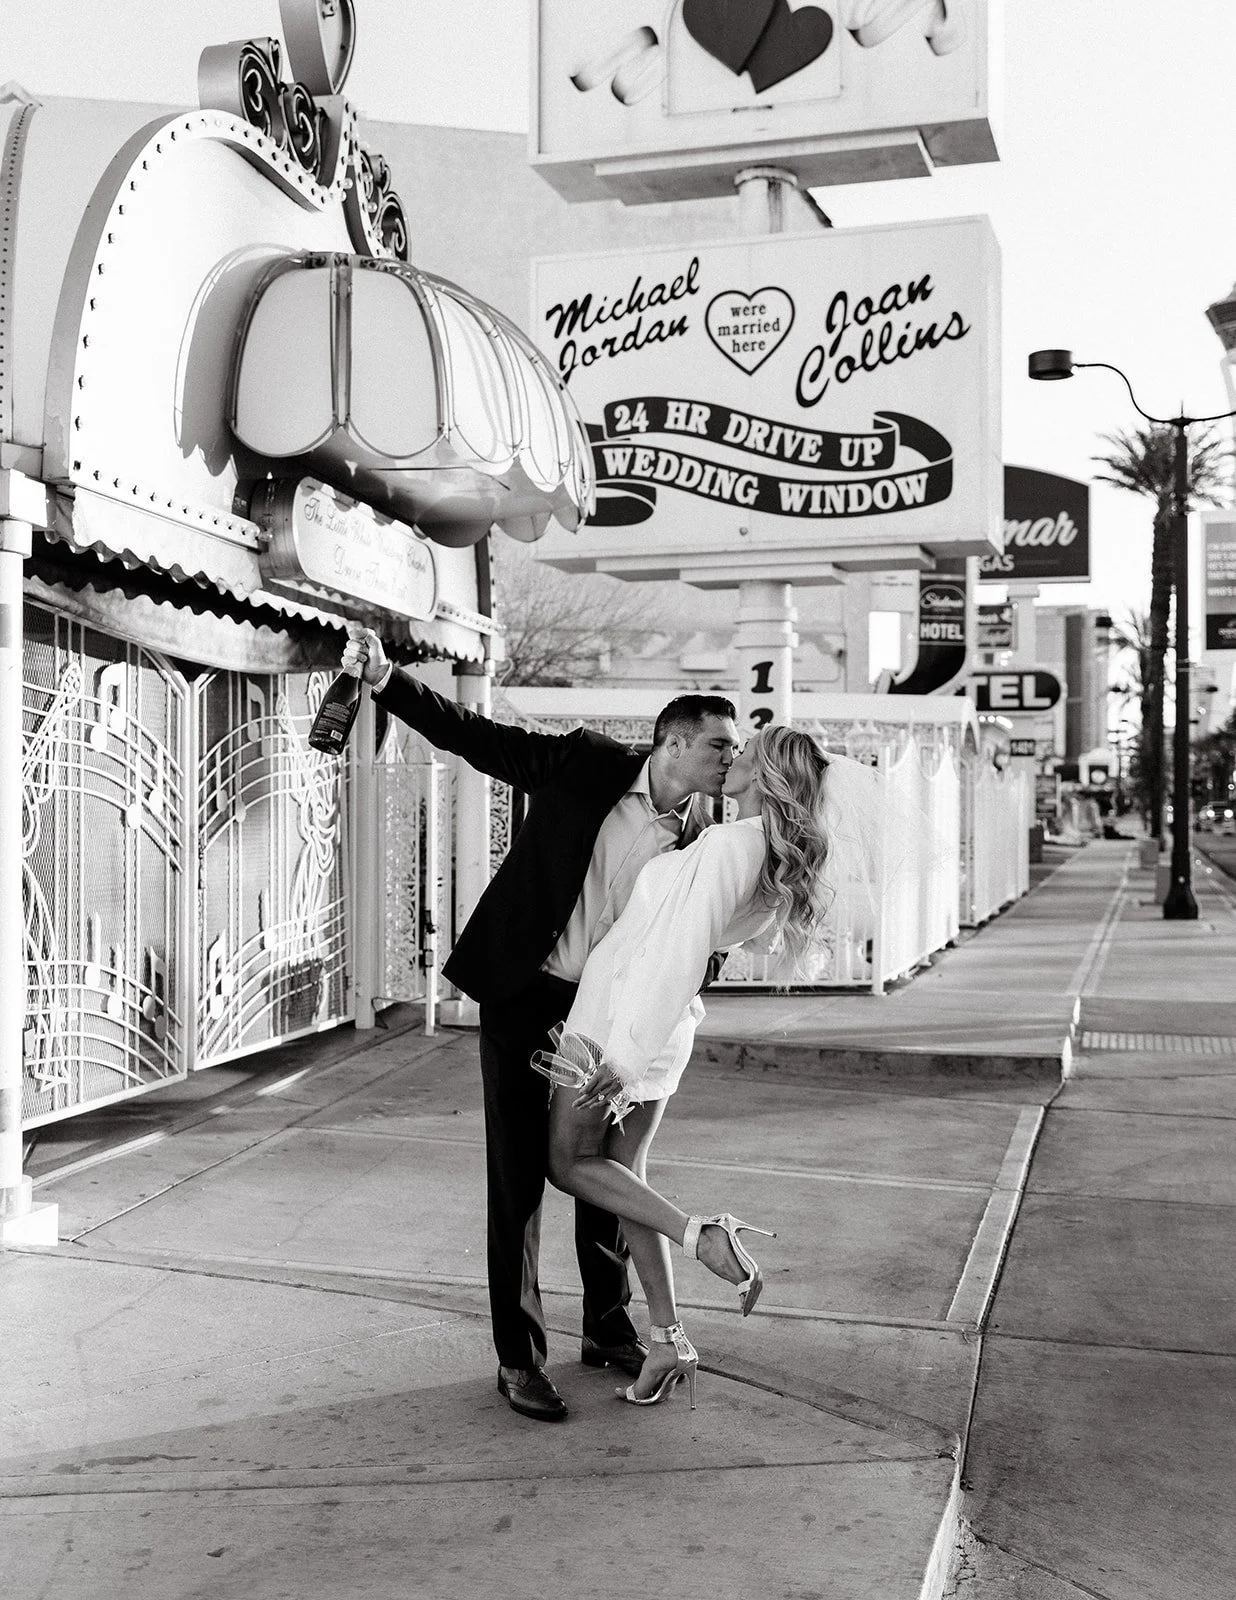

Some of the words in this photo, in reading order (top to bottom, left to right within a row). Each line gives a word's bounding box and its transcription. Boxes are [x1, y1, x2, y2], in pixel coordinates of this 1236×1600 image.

[545, 256, 700, 339] Michael
[717, 317, 780, 337] married
[730, 304, 766, 317] were
[825, 273, 934, 358] Joan
[559, 315, 689, 390] Jordan
[731, 339, 766, 353] here
[796, 311, 971, 408] Collins
[614, 402, 650, 433] 24
[663, 400, 711, 435] HR
[722, 413, 823, 464] DRIVE
[839, 436, 883, 467] UP
[603, 447, 760, 505] WEDDING
[778, 472, 929, 514] WINDOW
[919, 622, 965, 640] HOTEL
